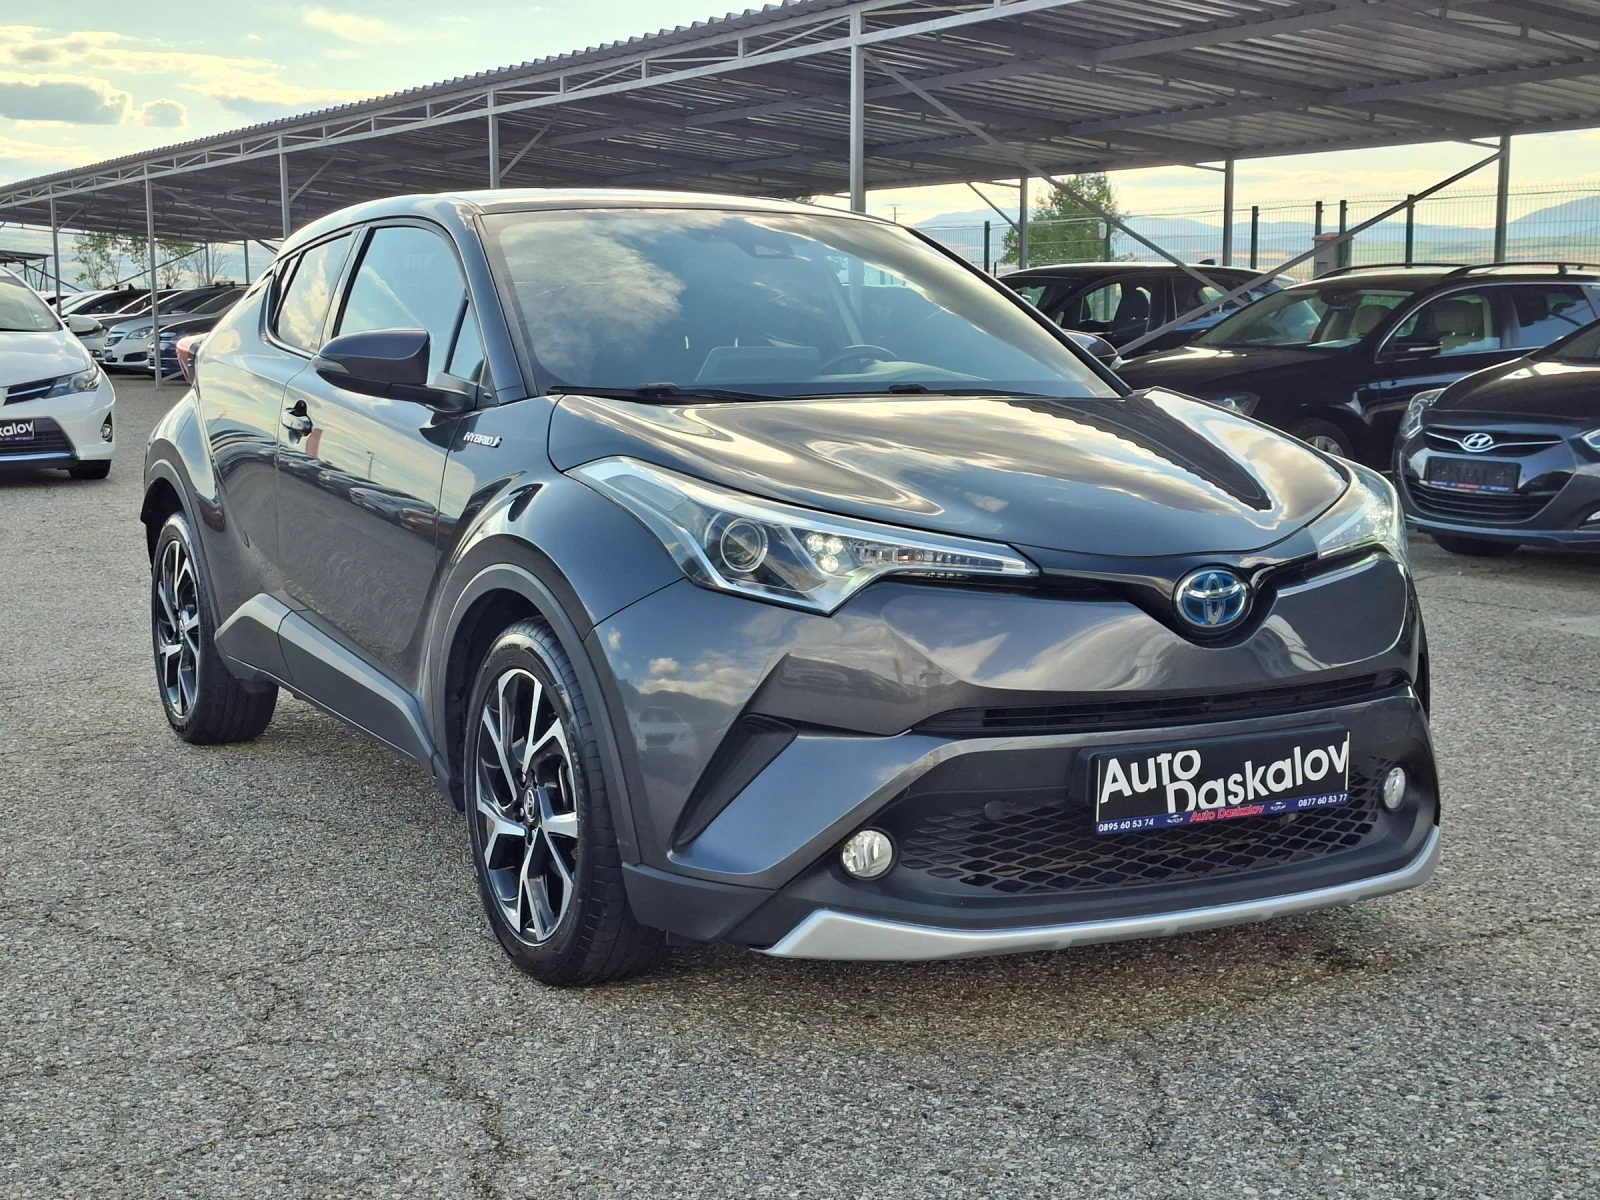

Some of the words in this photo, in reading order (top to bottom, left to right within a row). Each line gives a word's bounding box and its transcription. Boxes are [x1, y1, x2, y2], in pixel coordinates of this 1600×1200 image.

[463, 431, 494, 446] HYBRID
[1100, 749, 1202, 804] Auto
[1166, 740, 1349, 814] Daskalov
[1298, 797, 1316, 807] 0877
[1317, 796, 1327, 805] 60
[1328, 794, 1337, 803] 53
[1339, 793, 1348, 802] 77
[1189, 810, 1216, 822] Auto
[1217, 804, 1265, 819] Daskalov
[1098, 822, 1118, 832] 0895
[1120, 820, 1131, 829] 60
[1132, 819, 1142, 828] 53
[1144, 818, 1154, 827] 74
